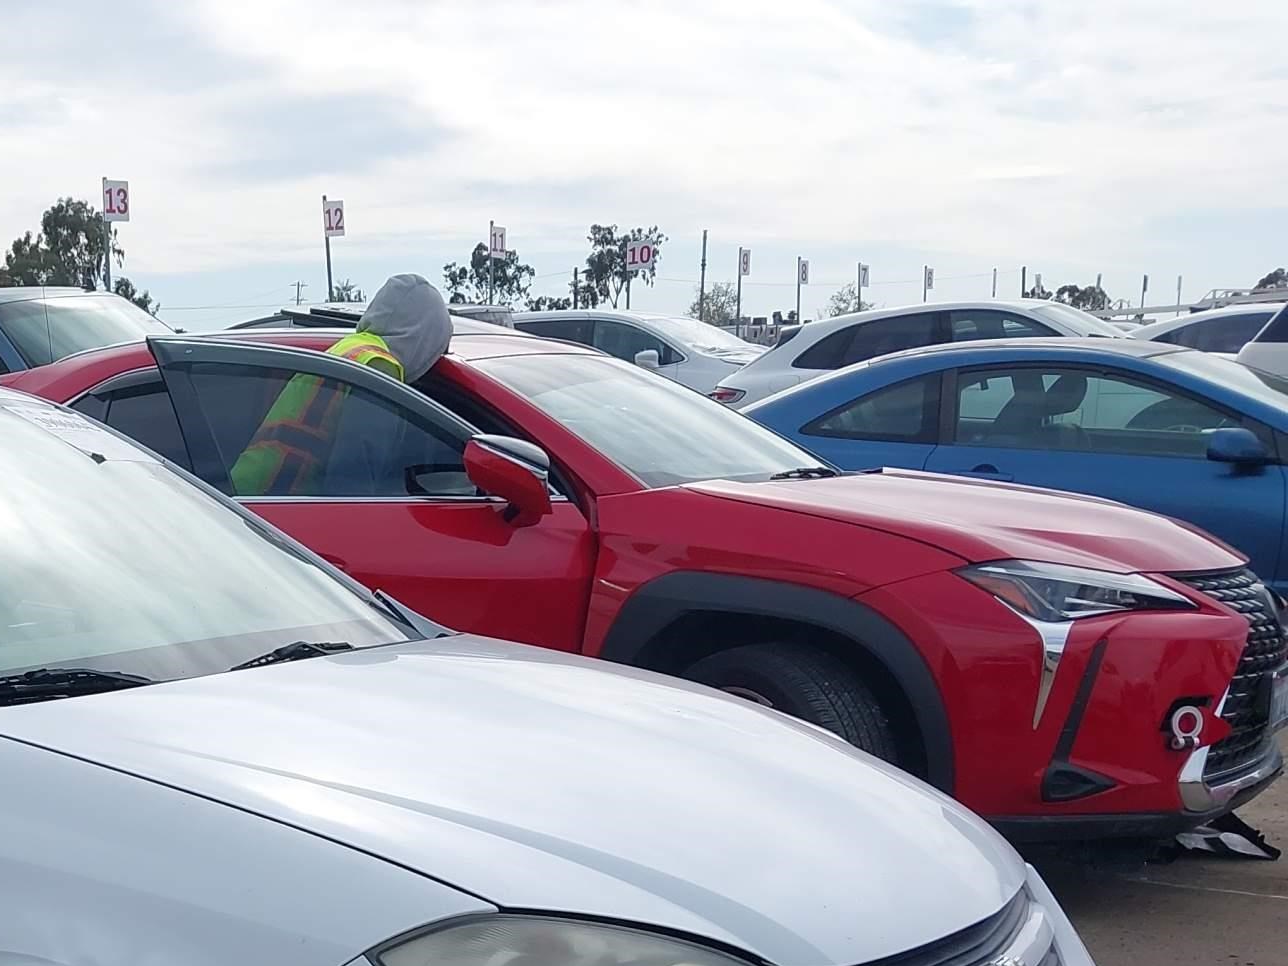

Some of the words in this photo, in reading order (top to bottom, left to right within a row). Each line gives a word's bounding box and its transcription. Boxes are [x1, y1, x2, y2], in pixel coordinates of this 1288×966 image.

[105, 188, 127, 214] 13
[326, 208, 344, 230] 12
[492, 232, 505, 252] 11
[629, 246, 650, 264] 10
[801, 263, 808, 282] 8
